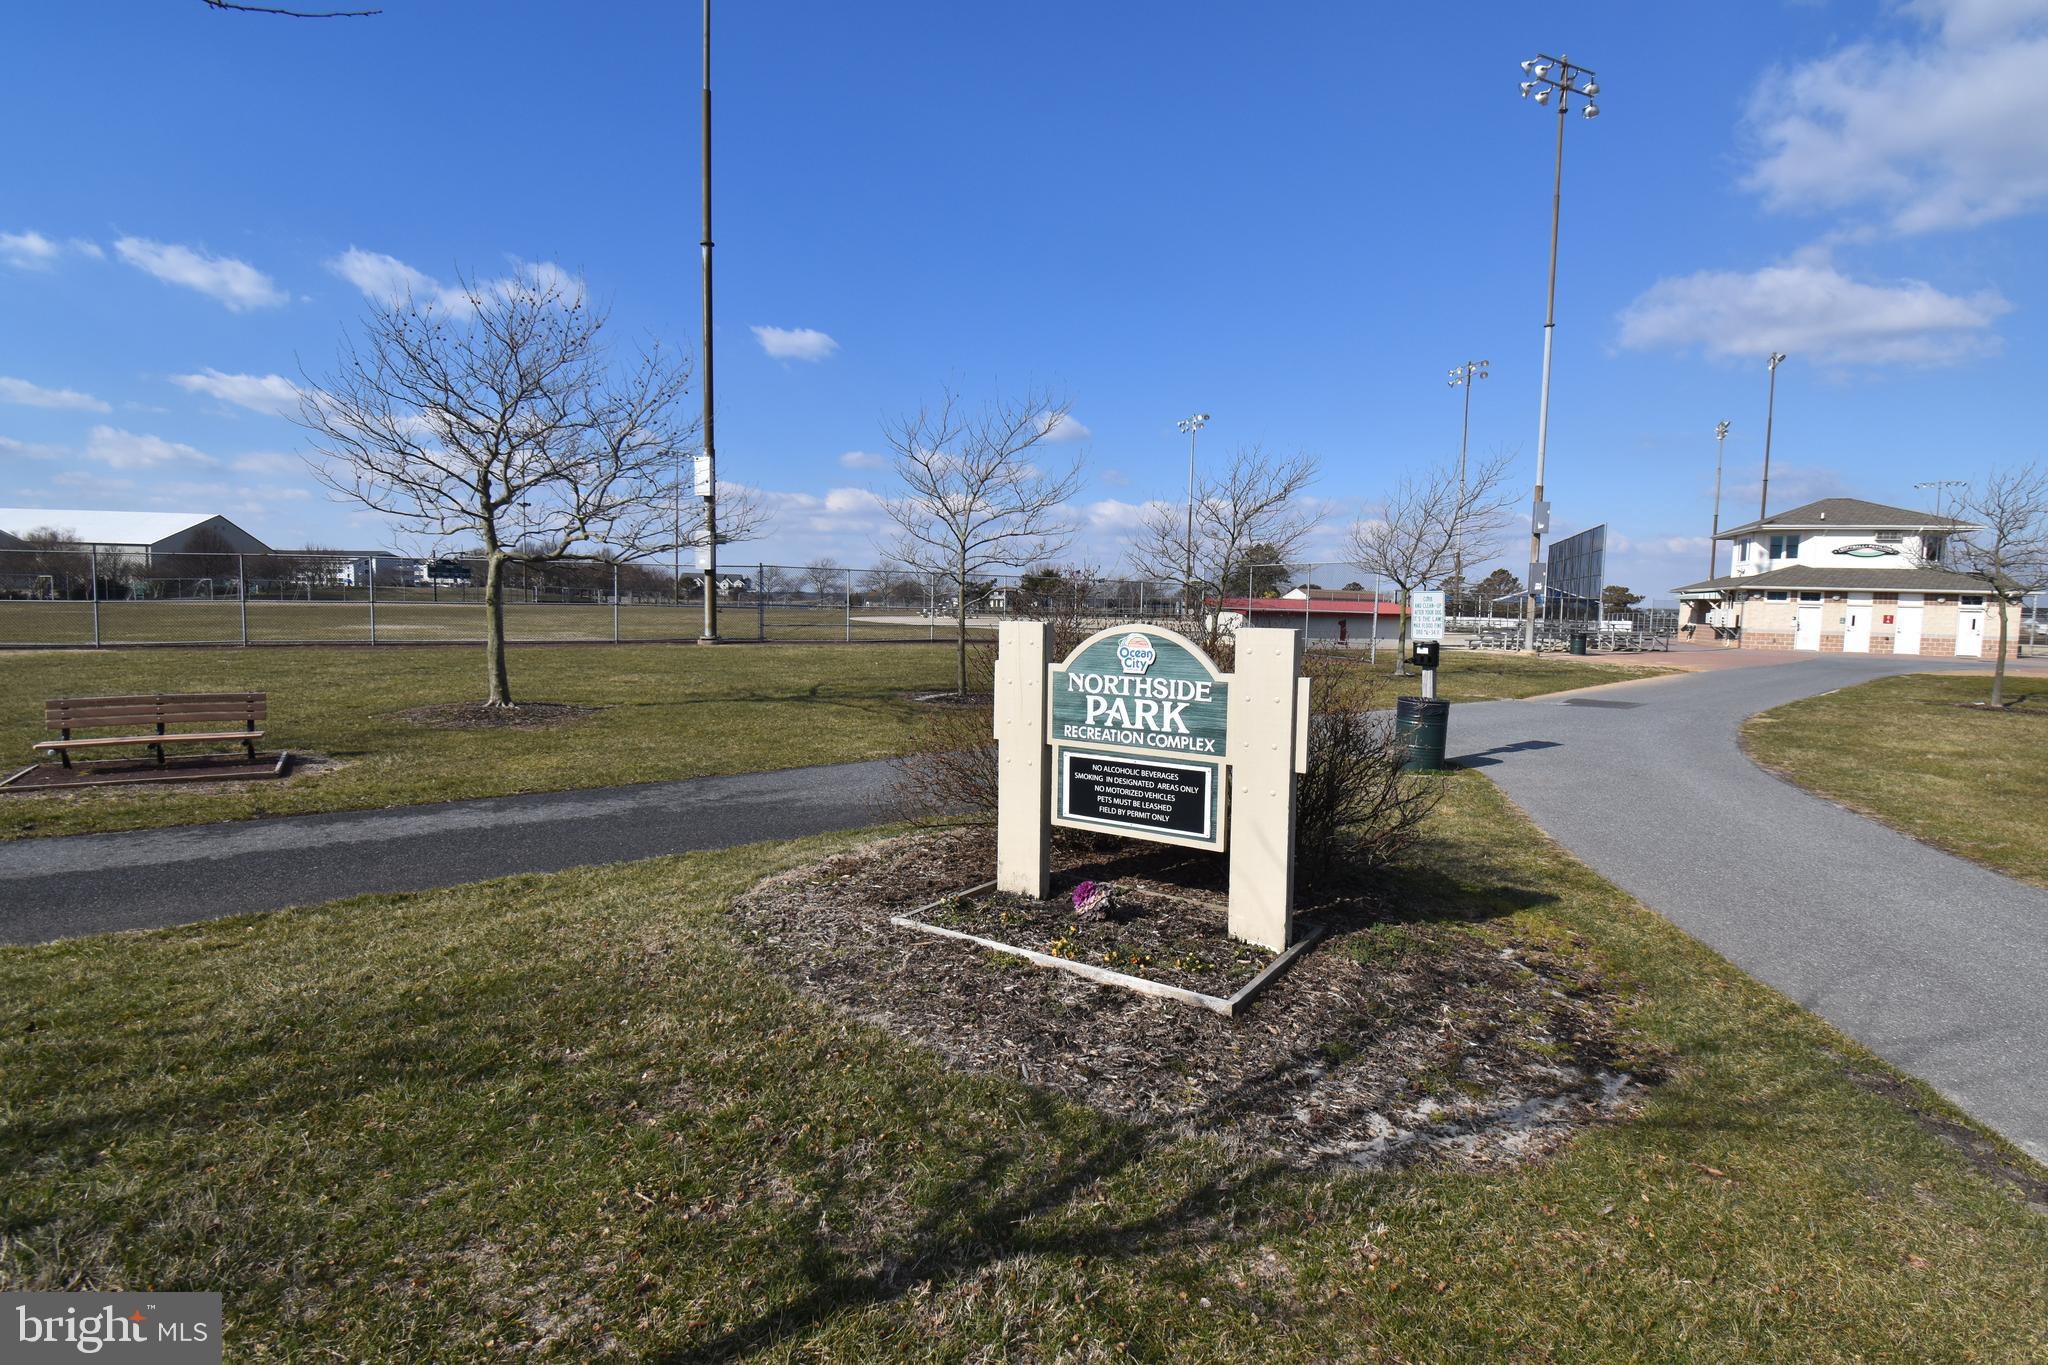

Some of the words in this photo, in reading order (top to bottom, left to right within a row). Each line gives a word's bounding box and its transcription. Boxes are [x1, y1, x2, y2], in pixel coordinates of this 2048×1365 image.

[1119, 647, 1153, 662] Ocean
[1124, 657, 1147, 672] City
[1068, 672, 1212, 703] NORTHSIDE
[1085, 695, 1190, 734] PARK
[1064, 724, 1144, 745] RECREATION
[1147, 733, 1215, 752] COMPLEX
[1103, 766, 1140, 776] ALCOHOLIC
[1141, 769, 1179, 781] BEVERAGES
[1074, 772, 1104, 782] SMOKING
[1114, 777, 1155, 788] DESIGNATED
[1157, 782, 1179, 792] AREAS
[1180, 785, 1199, 794] ONLY
[1105, 786, 1144, 798] MOTORIZED
[1144, 791, 1176, 802] VEHICLES
[1097, 795, 1112, 804] PETS
[1113, 797, 1131, 806] MUST
[1132, 800, 1141, 808] BE
[1142, 801, 1172, 812] LEASHED
[1099, 806, 1116, 815] FIELD
[1117, 808, 1126, 816] BY
[1126, 809, 1151, 820] PERMIT
[1151, 813, 1170, 822] ONLY
